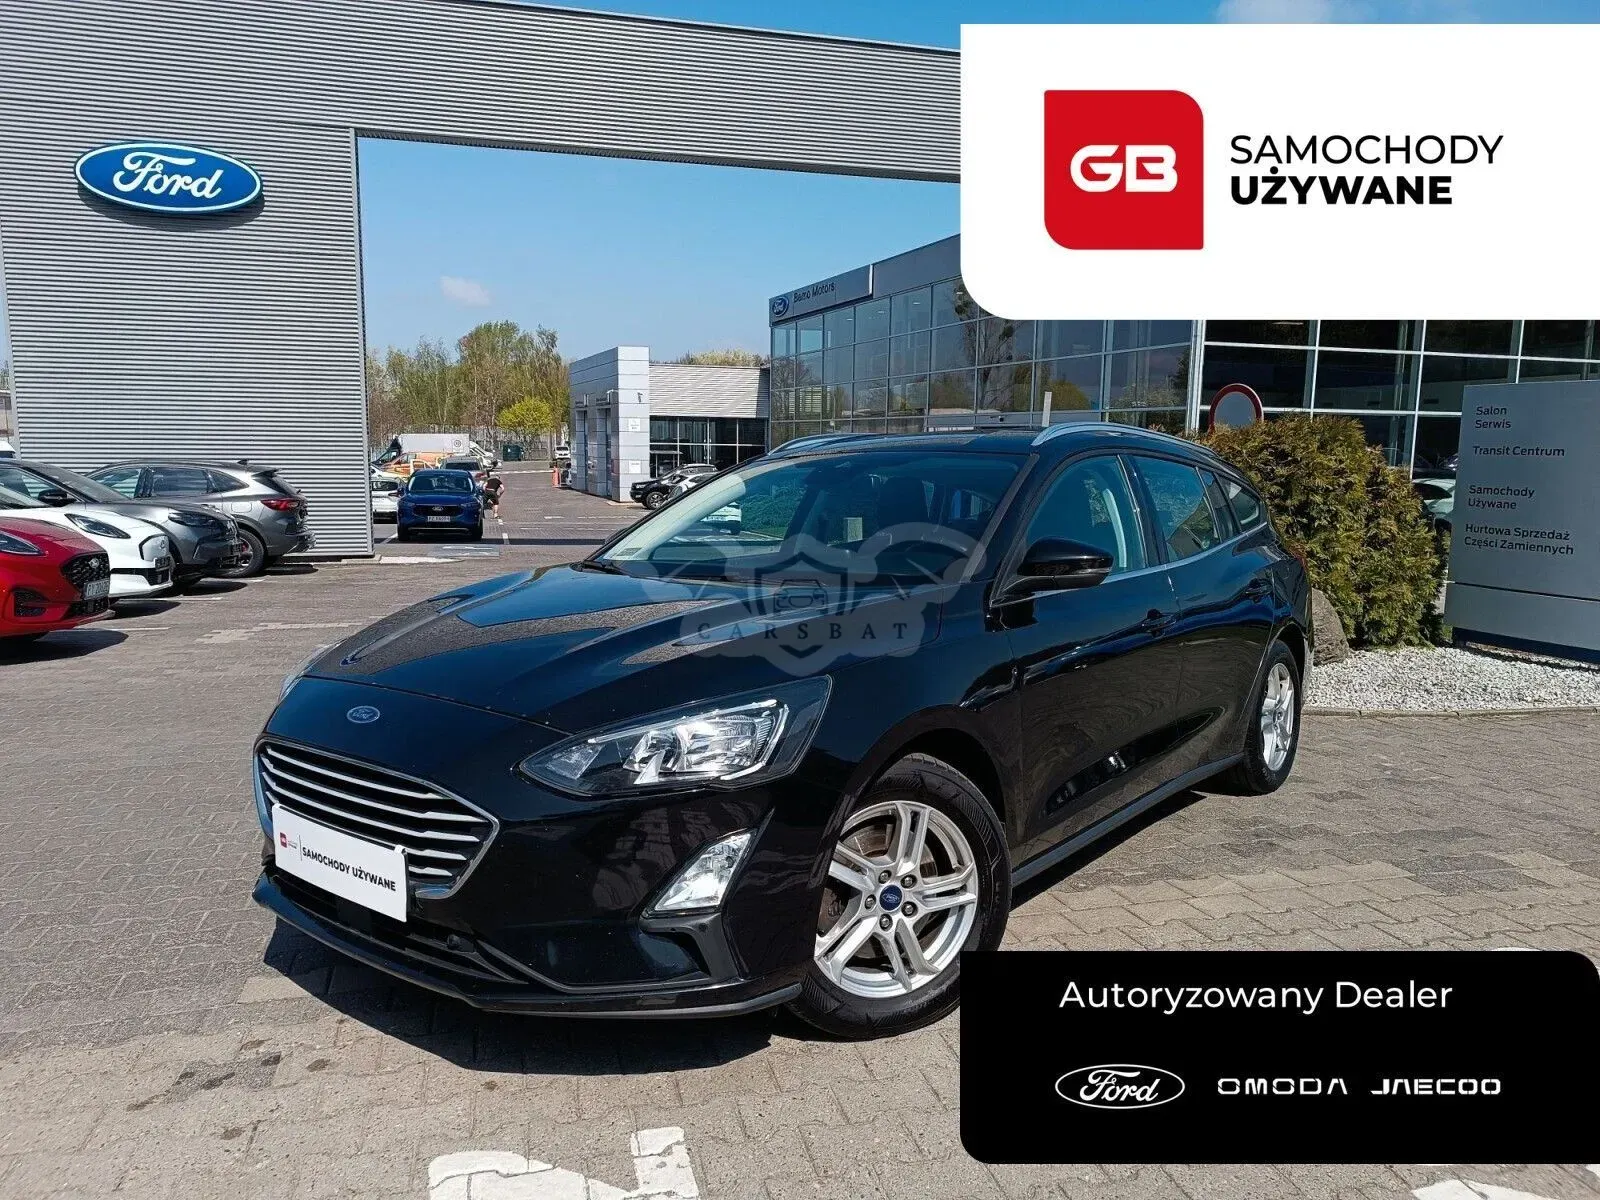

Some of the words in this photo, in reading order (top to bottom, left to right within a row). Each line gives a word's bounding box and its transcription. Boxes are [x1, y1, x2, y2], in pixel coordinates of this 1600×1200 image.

[113, 151, 224, 199] Ford
[811, 282, 835, 298] Motors
[1475, 406, 1507, 416] Salon
[1475, 419, 1511, 429] Serwis
[1472, 445, 1509, 456] Transit
[1512, 446, 1565, 457] Centrum
[1469, 485, 1535, 499] Samochody
[1468, 498, 1517, 510] Używane
[1465, 523, 1511, 536] Hurtowa
[1513, 527, 1570, 541] Sprzedaż
[1464, 537, 1498, 549] Części
[1500, 539, 1574, 555] Zamiennych
[302, 846, 350, 875] SAMOCHODY
[352, 866, 396, 892] UŻYWANE
